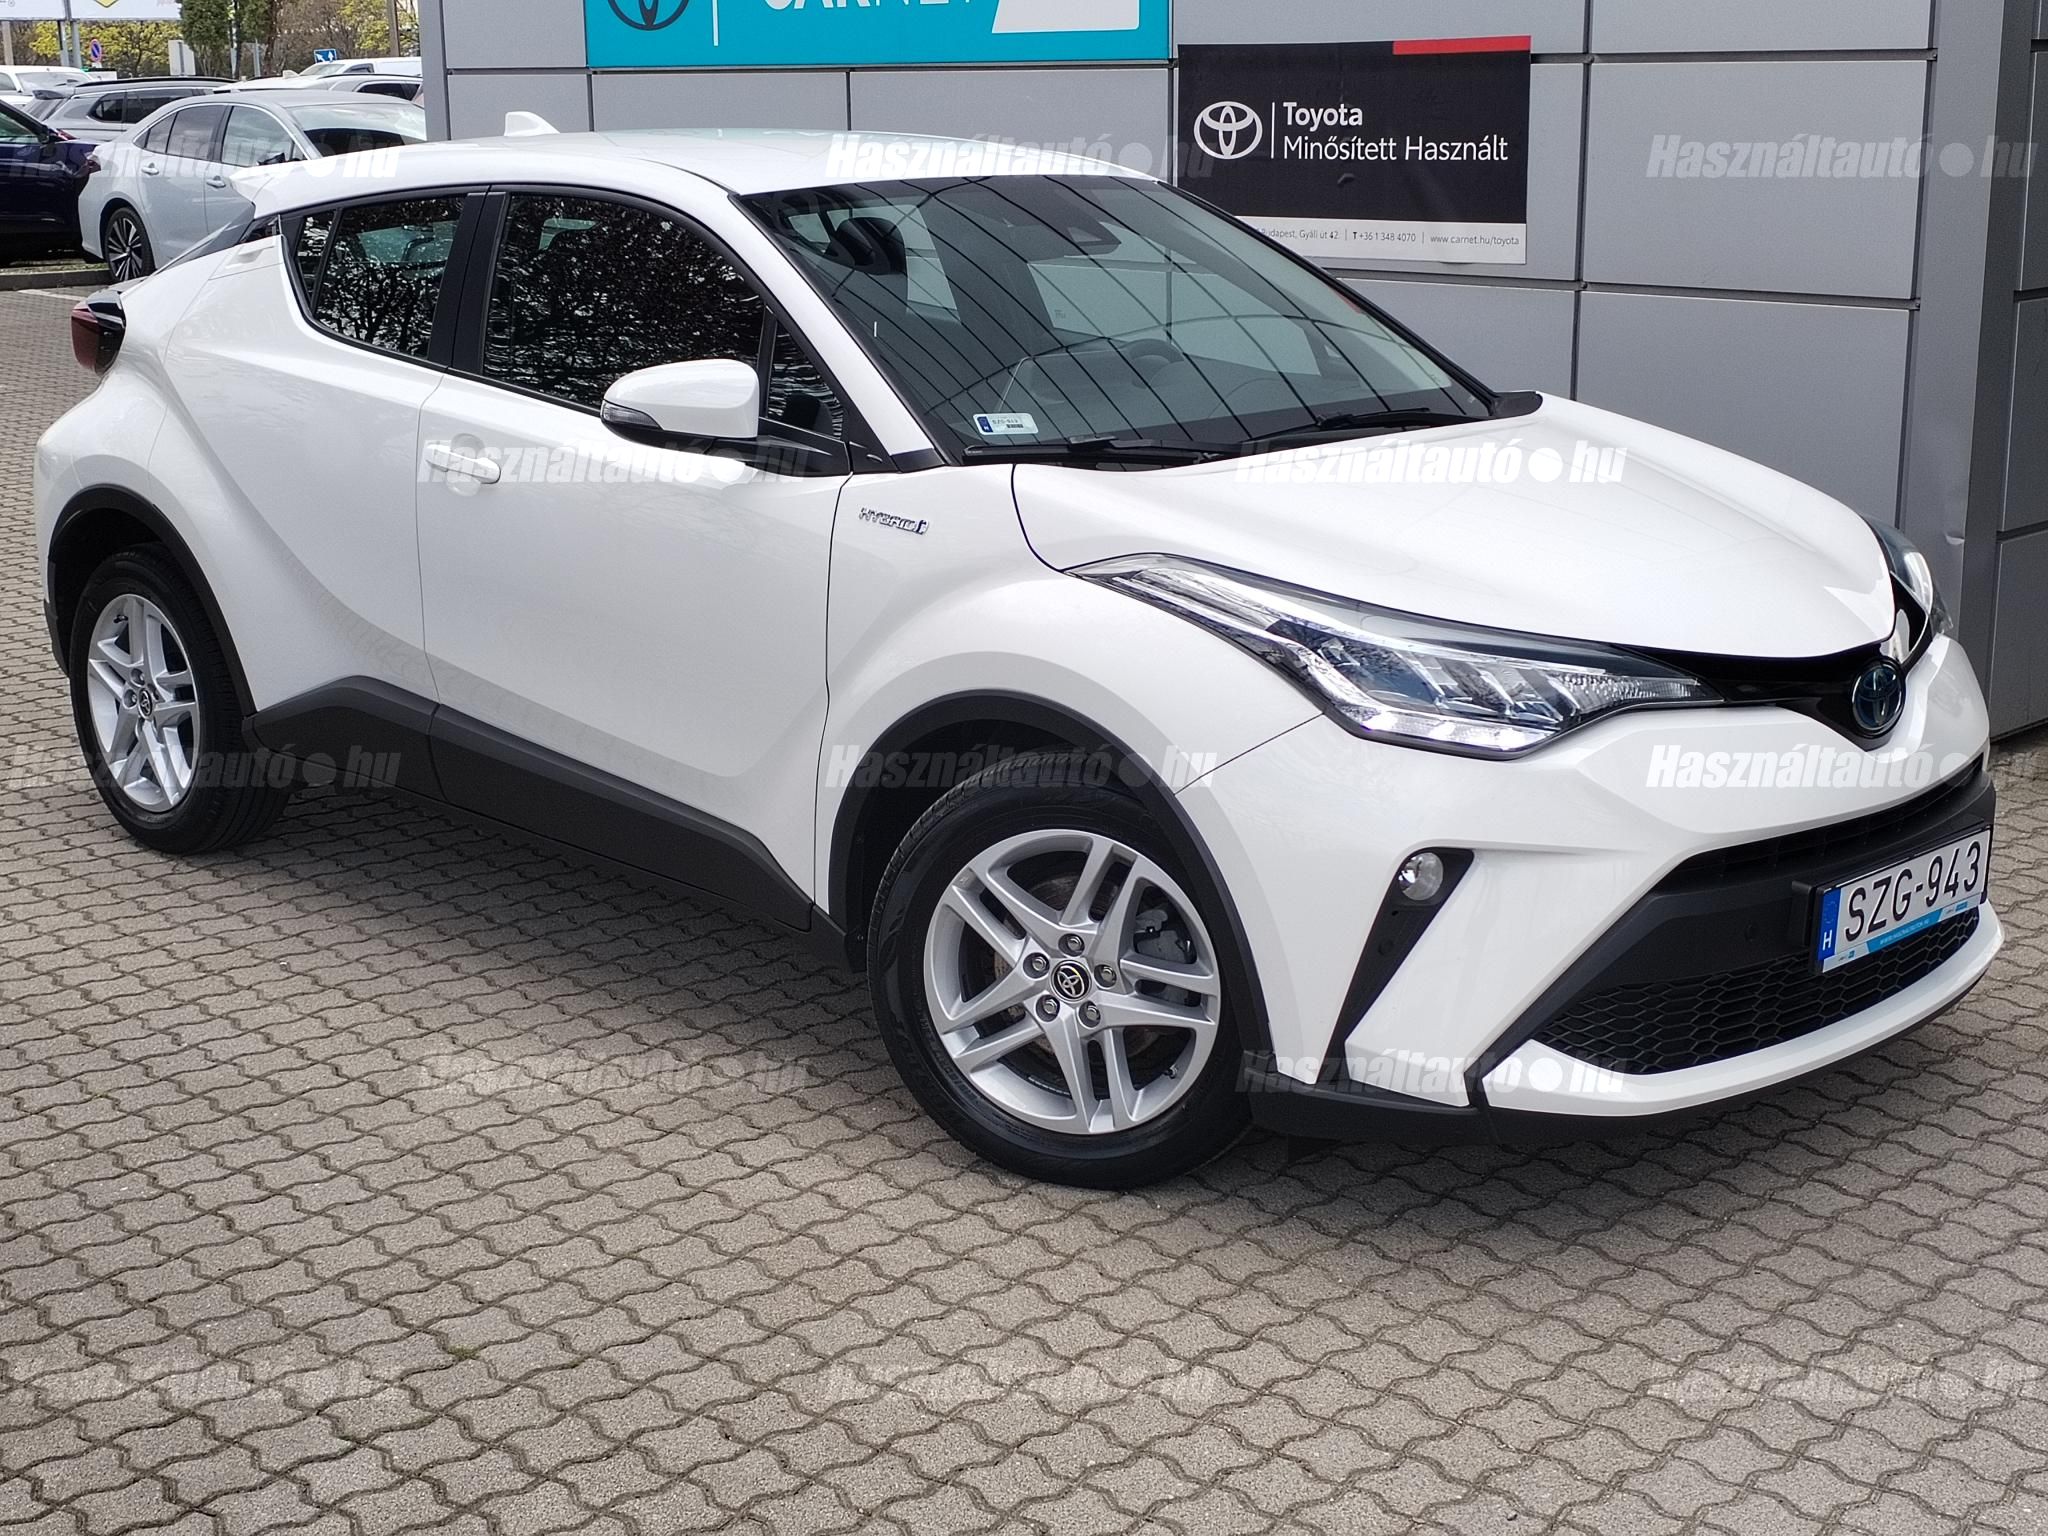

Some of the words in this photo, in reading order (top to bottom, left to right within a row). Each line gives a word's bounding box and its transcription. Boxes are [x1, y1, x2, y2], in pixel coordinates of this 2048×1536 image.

[1283, 102, 1363, 132] Toyota
[1284, 136, 1397, 161] Minősített
[1405, 134, 1509, 162] Használt
[1844, 840, 1982, 942] SZG-943
